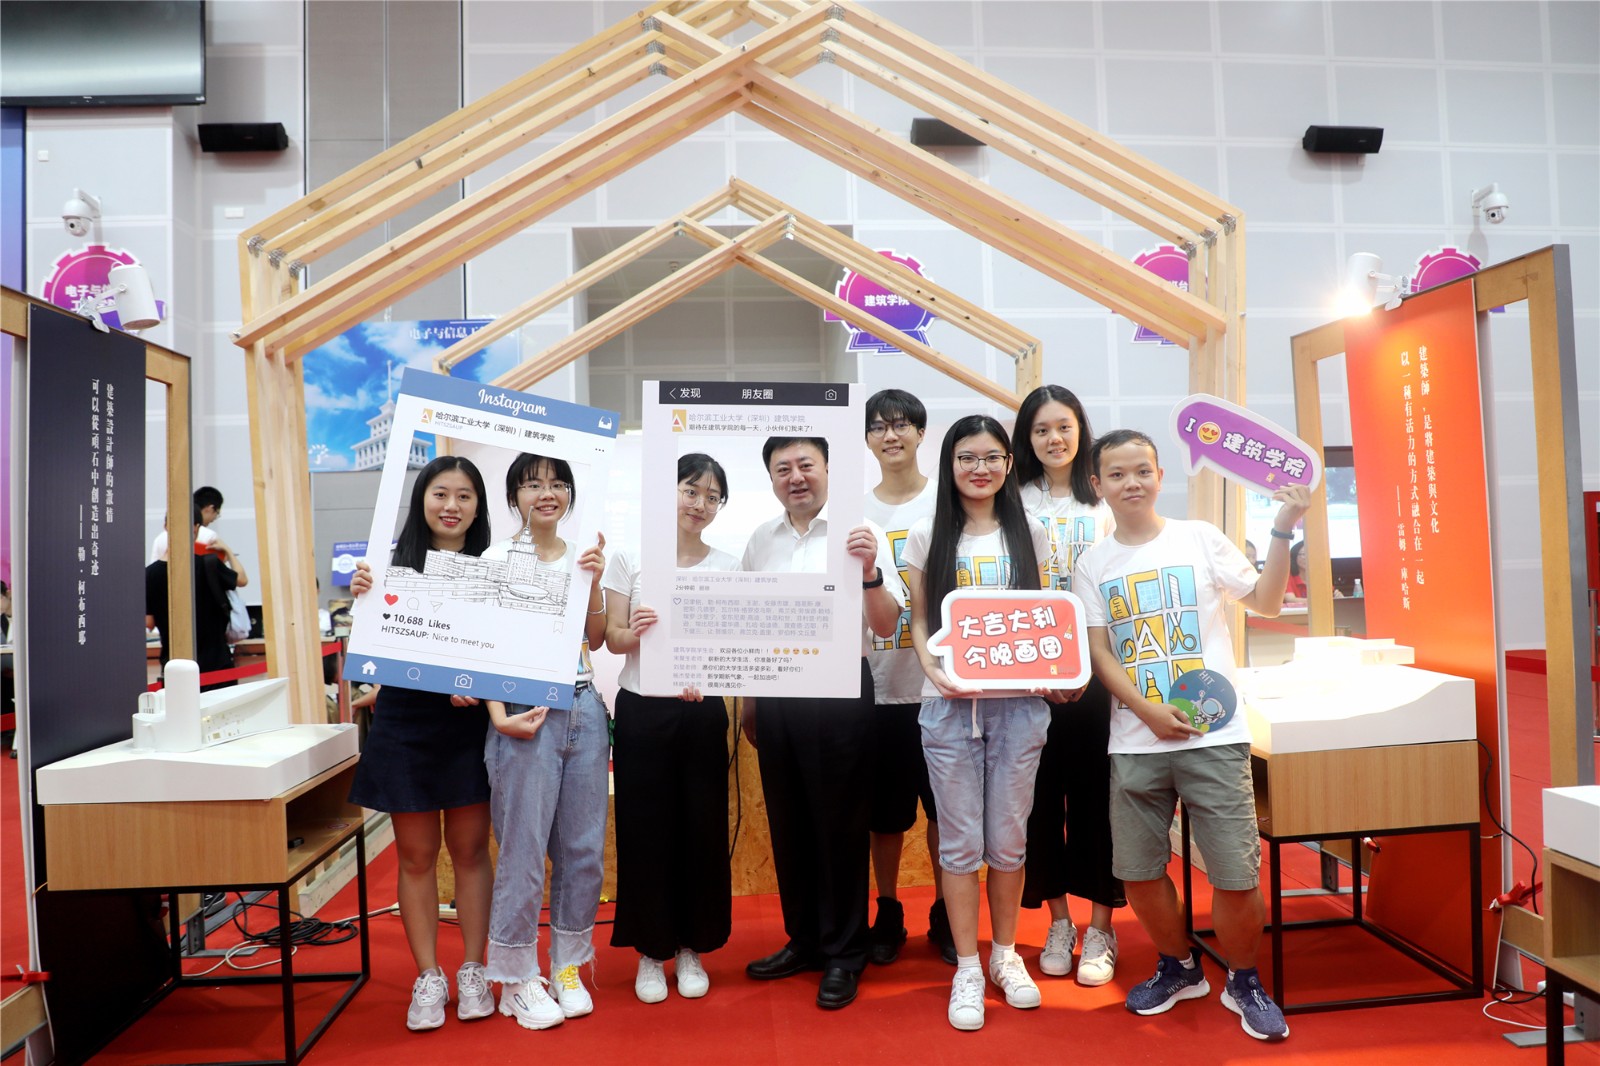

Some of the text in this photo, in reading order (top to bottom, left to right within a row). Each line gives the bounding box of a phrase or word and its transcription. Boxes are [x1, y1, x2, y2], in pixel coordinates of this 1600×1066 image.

[864, 293, 910, 307] 建筑学院
[477, 388, 548, 417] Instagram
[680, 387, 701, 399] 发现
[741, 388, 774, 400] 朋友圈
[524, 430, 556, 443] 建筑学院
[1184, 417, 1307, 479] I 建筑学院
[1400, 350, 1425, 585] 以一種有活力的方式融合在一起
[393, 614, 451, 630] 10,688 Likes
[957, 604, 1058, 639] 大吉大利
[381, 625, 430, 639] HITSZSAUP:
[432, 633, 449, 642] Nice
[460, 638, 479, 647] meet
[963, 635, 1064, 669] 今晚画图
[1199, 670, 1215, 686] HIT
